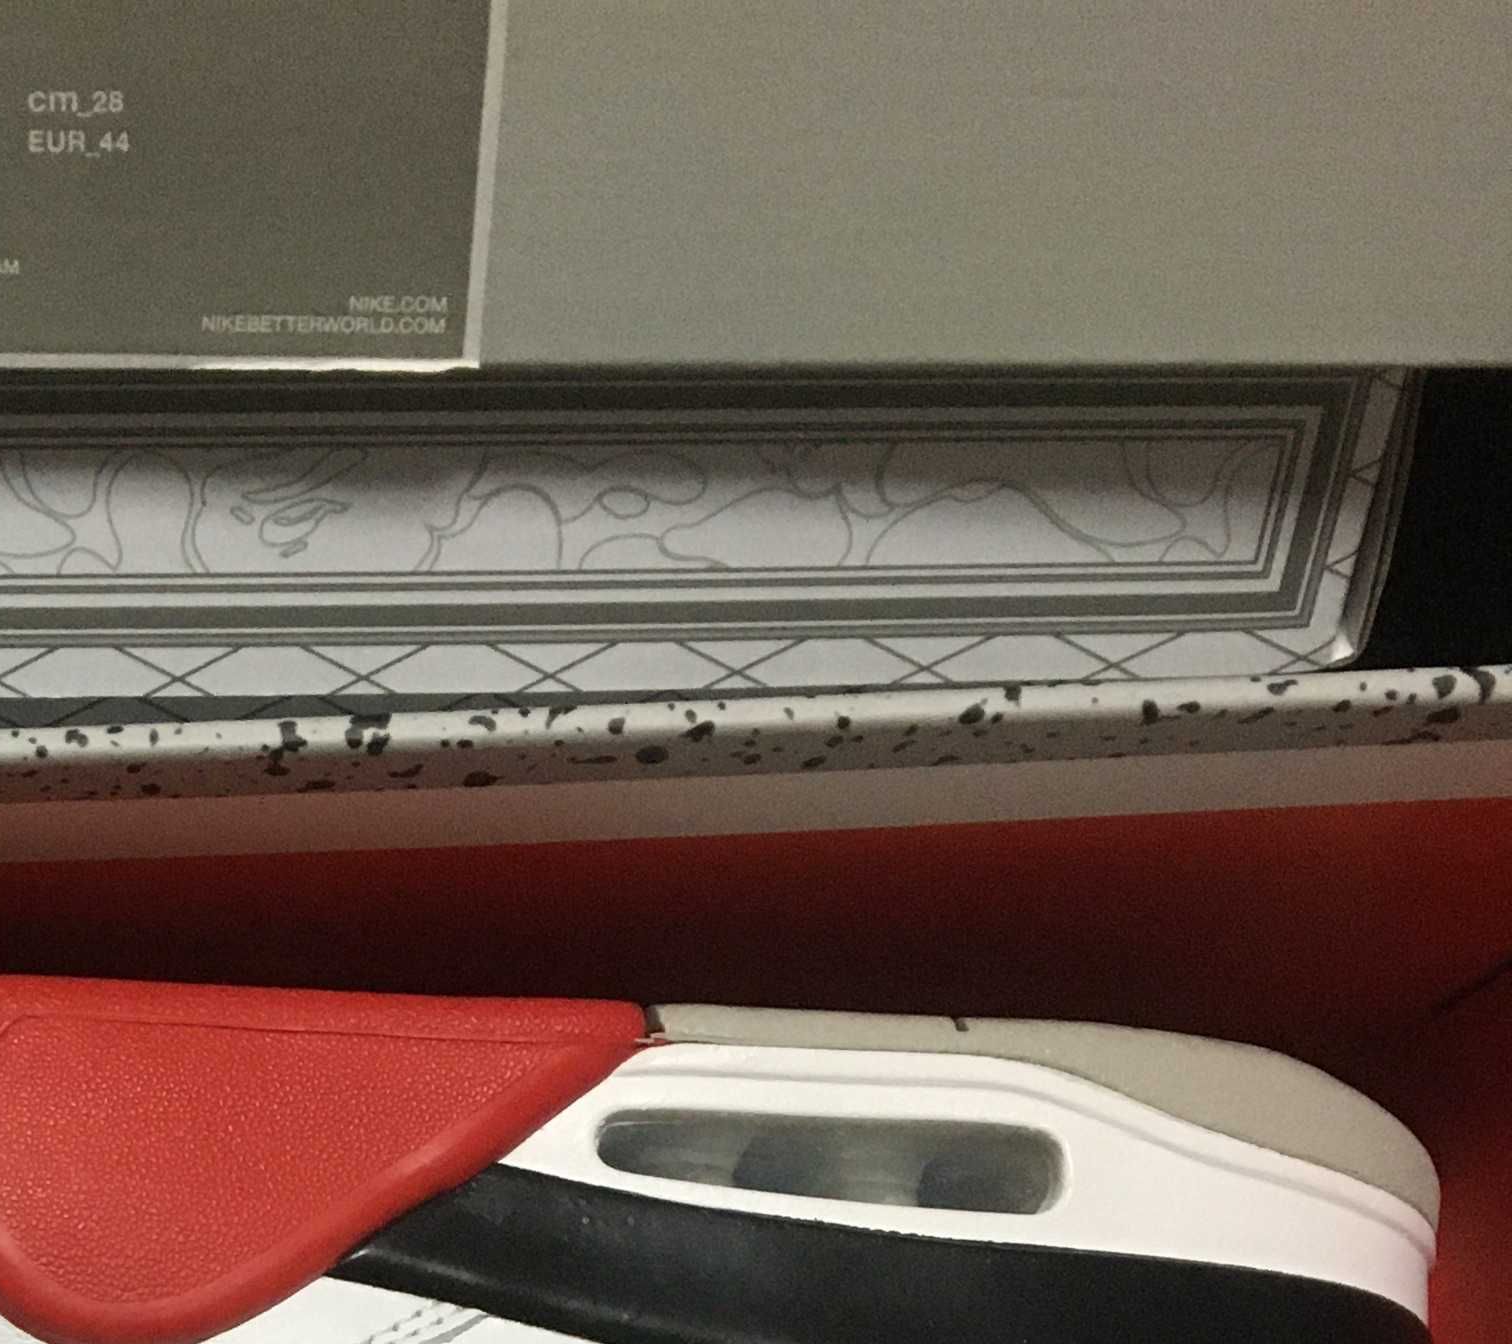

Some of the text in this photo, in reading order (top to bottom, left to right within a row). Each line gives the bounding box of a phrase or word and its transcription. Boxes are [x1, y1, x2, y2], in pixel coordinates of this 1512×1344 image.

[28, 130, 130, 158] EUR_44
[349, 295, 448, 313] NIKE.COM
[201, 315, 446, 334] NIKEBETTERWORLD.COM
